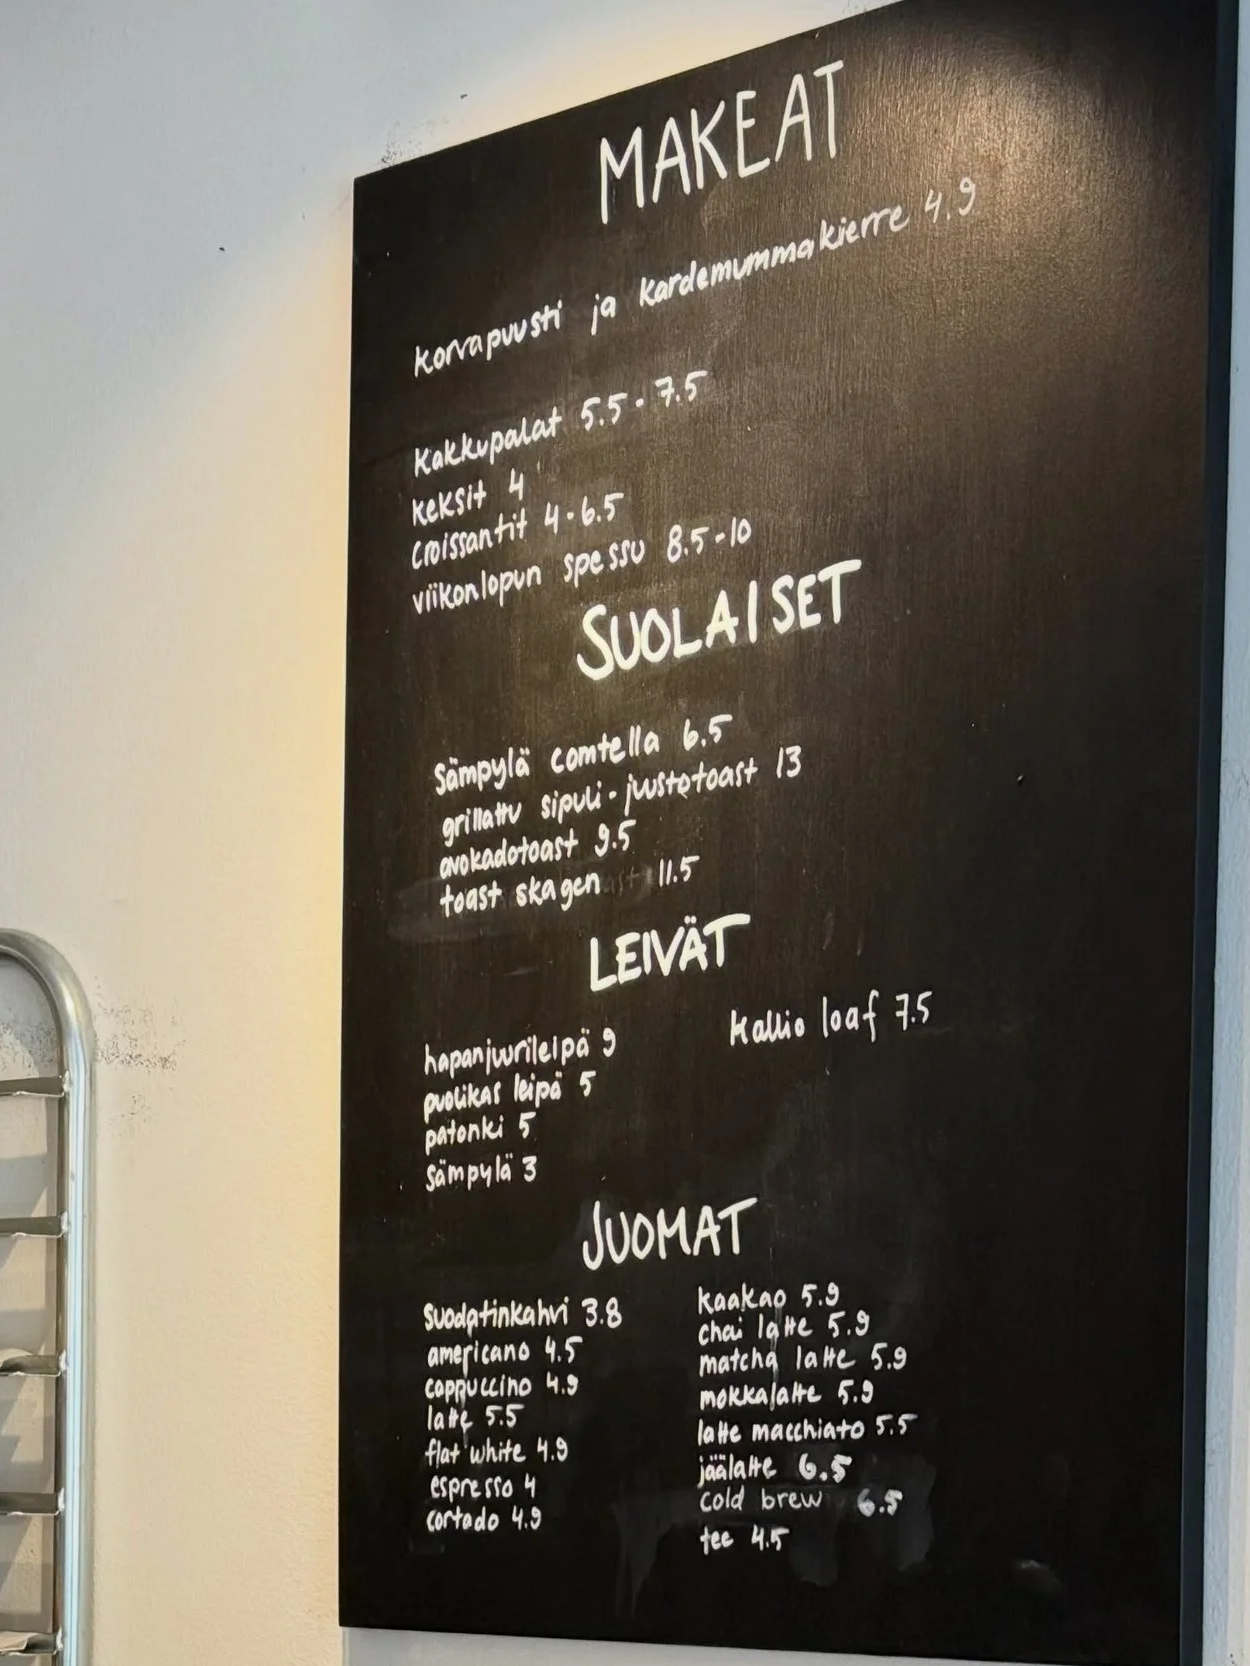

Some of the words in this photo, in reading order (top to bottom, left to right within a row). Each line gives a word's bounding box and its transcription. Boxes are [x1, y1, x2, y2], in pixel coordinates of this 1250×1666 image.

[600, 60, 846, 224] MAKEAT
[591, 293, 616, 336] ja
[925, 178, 975, 223] 4.9
[509, 468, 523, 500] 4
[412, 566, 541, 614] viikonlopun
[564, 540, 645, 588] spessu
[578, 559, 862, 680] SUOLAISET
[551, 725, 659, 774] comtella
[683, 714, 733, 751] 6.5
[442, 802, 522, 847] grillattu
[776, 745, 801, 778] 13
[439, 828, 579, 880] avokadotoast
[594, 819, 636, 857] 9.5
[440, 881, 502, 918] toast
[516, 873, 600, 911] skagen
[659, 855, 700, 887] 11.5
[590, 913, 751, 992] LEIVÄT
[823, 989, 879, 1042] loaf
[896, 991, 932, 1031] 7.5
[424, 1028, 590, 1080] hapanjuurileipä
[603, 1028, 616, 1057] 9
[424, 1081, 504, 1124] puolikas
[514, 1071, 562, 1108] leipä
[580, 1070, 596, 1097] 5
[425, 1115, 504, 1156] patonki
[519, 1112, 536, 1139] 5
[522, 1155, 537, 1182] 3
[583, 1197, 758, 1270] JUOMAT
[582, 1297, 622, 1328] 3.8
[802, 1282, 839, 1308] 5.9
[699, 1319, 742, 1344] chai
[759, 1315, 813, 1341] latte
[828, 1310, 870, 1338] 5.9
[428, 1341, 530, 1369] americano
[545, 1336, 583, 1363] 4.5
[699, 1349, 778, 1377] matcha
[797, 1347, 855, 1370] latte
[871, 1342, 907, 1370] 5.9
[547, 1372, 578, 1396] 4.9
[700, 1381, 822, 1410] mokkalatte
[838, 1379, 873, 1405] 5.9
[428, 1406, 472, 1429] latte
[486, 1404, 524, 1428] 5.5
[699, 1419, 741, 1444] latte
[752, 1418, 865, 1442] macchiato
[876, 1414, 917, 1435] 5.5
[426, 1440, 460, 1466] flat
[470, 1437, 526, 1464] white
[537, 1437, 568, 1462] 4.9
[431, 1475, 513, 1503] espresso
[525, 1473, 535, 1498] 4
[697, 1454, 777, 1488] jäälatte
[799, 1453, 852, 1483] 6.5
[426, 1506, 499, 1532] cortado
[512, 1505, 541, 1530] 4.9
[762, 1488, 822, 1510] brew
[857, 1488, 903, 1517] 6.5
[700, 1526, 734, 1555] tee
[751, 1524, 789, 1551] 4.5
